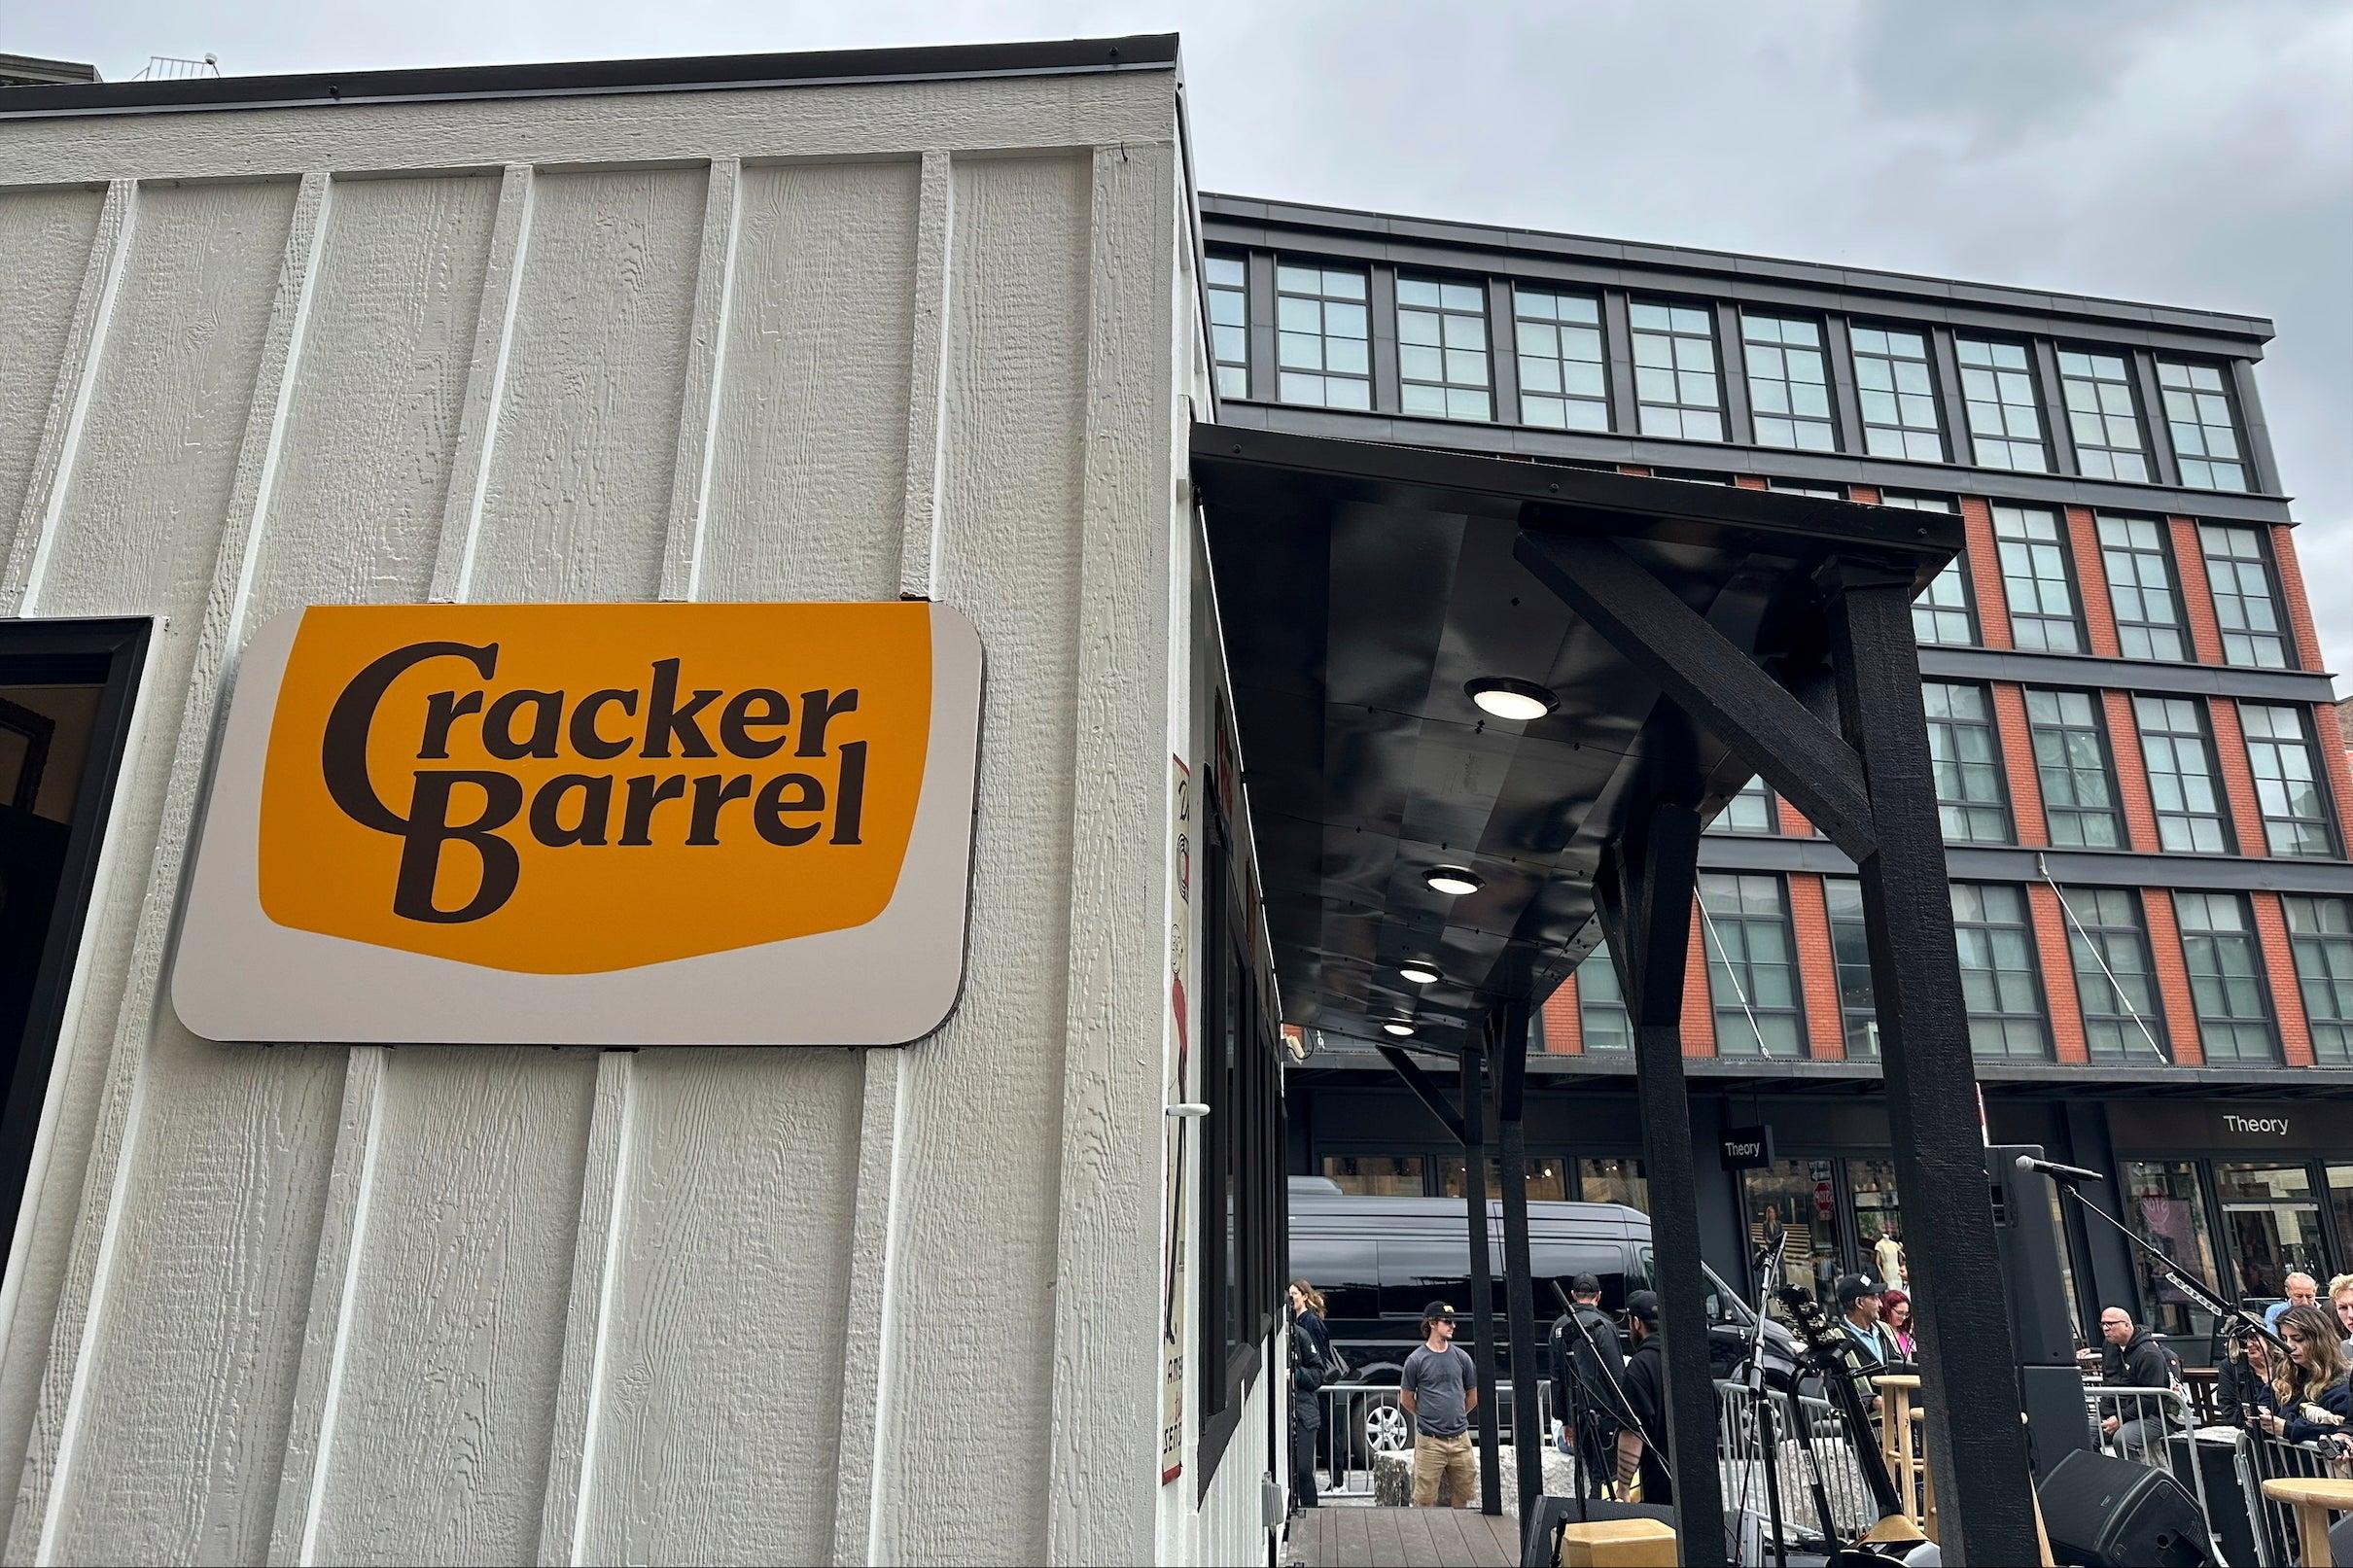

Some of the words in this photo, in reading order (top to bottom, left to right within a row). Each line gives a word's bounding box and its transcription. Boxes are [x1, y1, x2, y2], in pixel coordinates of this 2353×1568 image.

[322, 641, 859, 836] Cracker
[393, 740, 867, 924] Barrel
[1724, 1141, 1761, 1158] Theory
[2223, 1114, 2289, 1136] Theory
